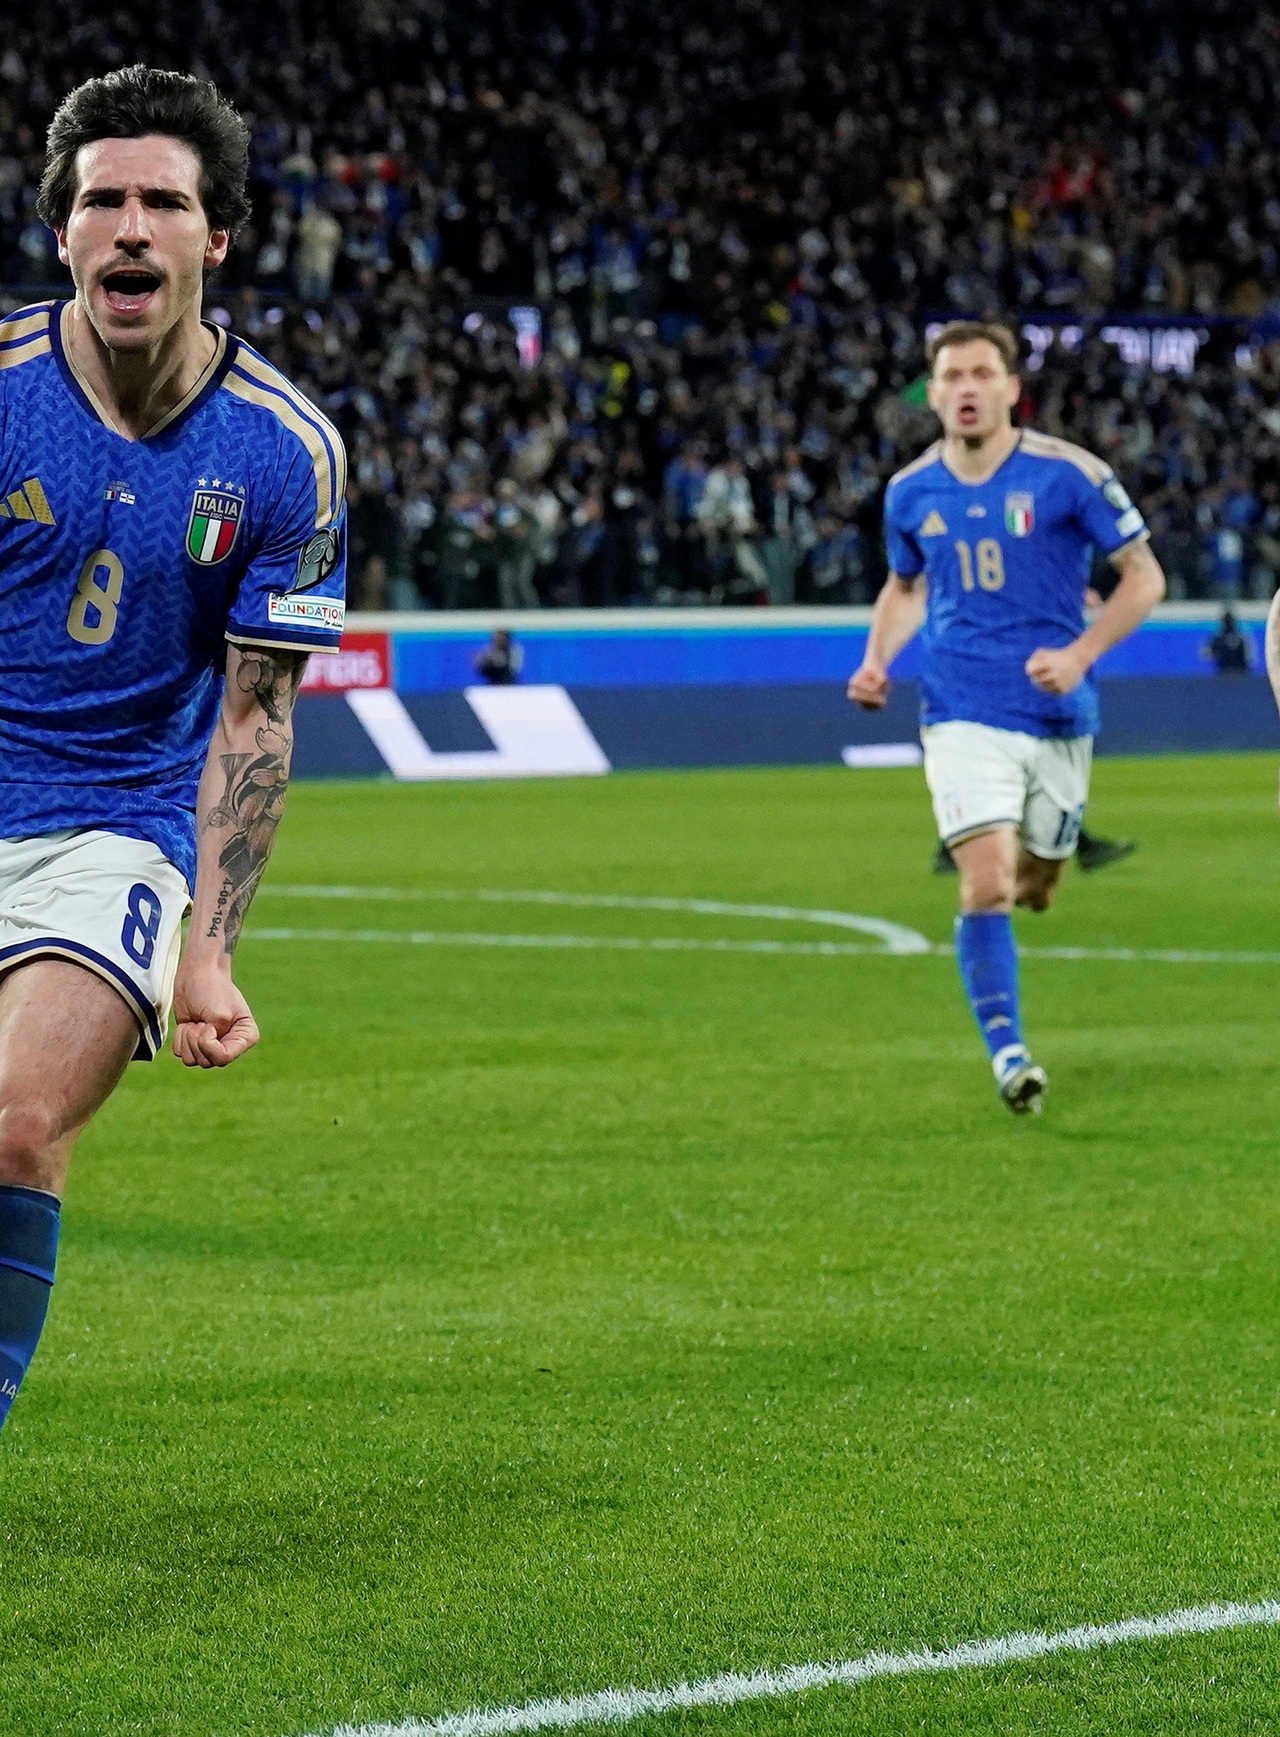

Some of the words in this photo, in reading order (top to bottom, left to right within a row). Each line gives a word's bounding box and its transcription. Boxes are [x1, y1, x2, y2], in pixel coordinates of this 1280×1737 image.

[196, 495, 238, 517] ITALIA
[955, 538, 1005, 592] 18
[66, 549, 124, 645] 8
[271, 602, 344, 621] FOUNDATION
[121, 882, 162, 970] 8
